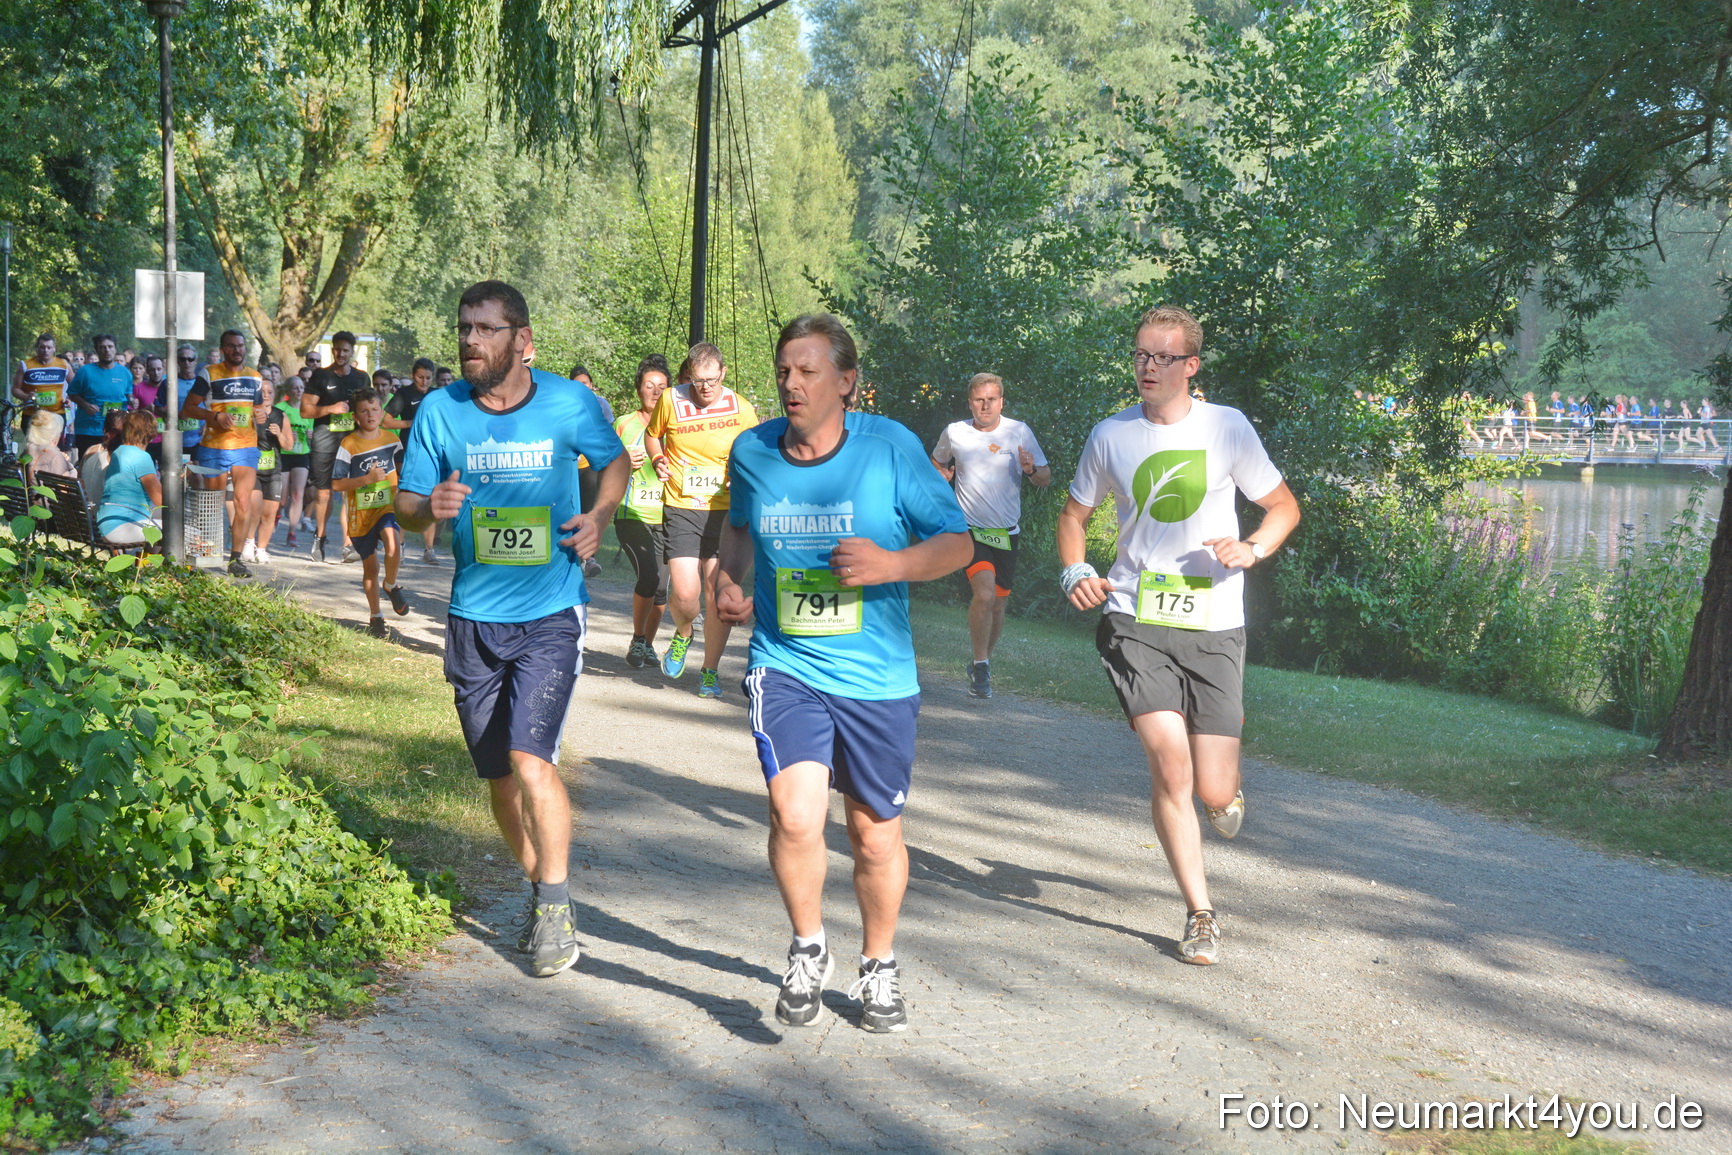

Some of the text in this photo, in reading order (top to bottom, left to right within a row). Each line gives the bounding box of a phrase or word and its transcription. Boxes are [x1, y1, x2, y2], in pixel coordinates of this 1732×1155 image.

[676, 418, 741, 435] MAX BÖGL
[466, 451, 554, 470] NEUMARKT
[688, 476, 719, 487] 1214
[364, 491, 384, 502] 579
[760, 514, 854, 533] NEUMARKT
[488, 528, 533, 549] 792
[980, 533, 1001, 544] 990
[793, 593, 839, 616] 791
[1155, 591, 1195, 613] 175
